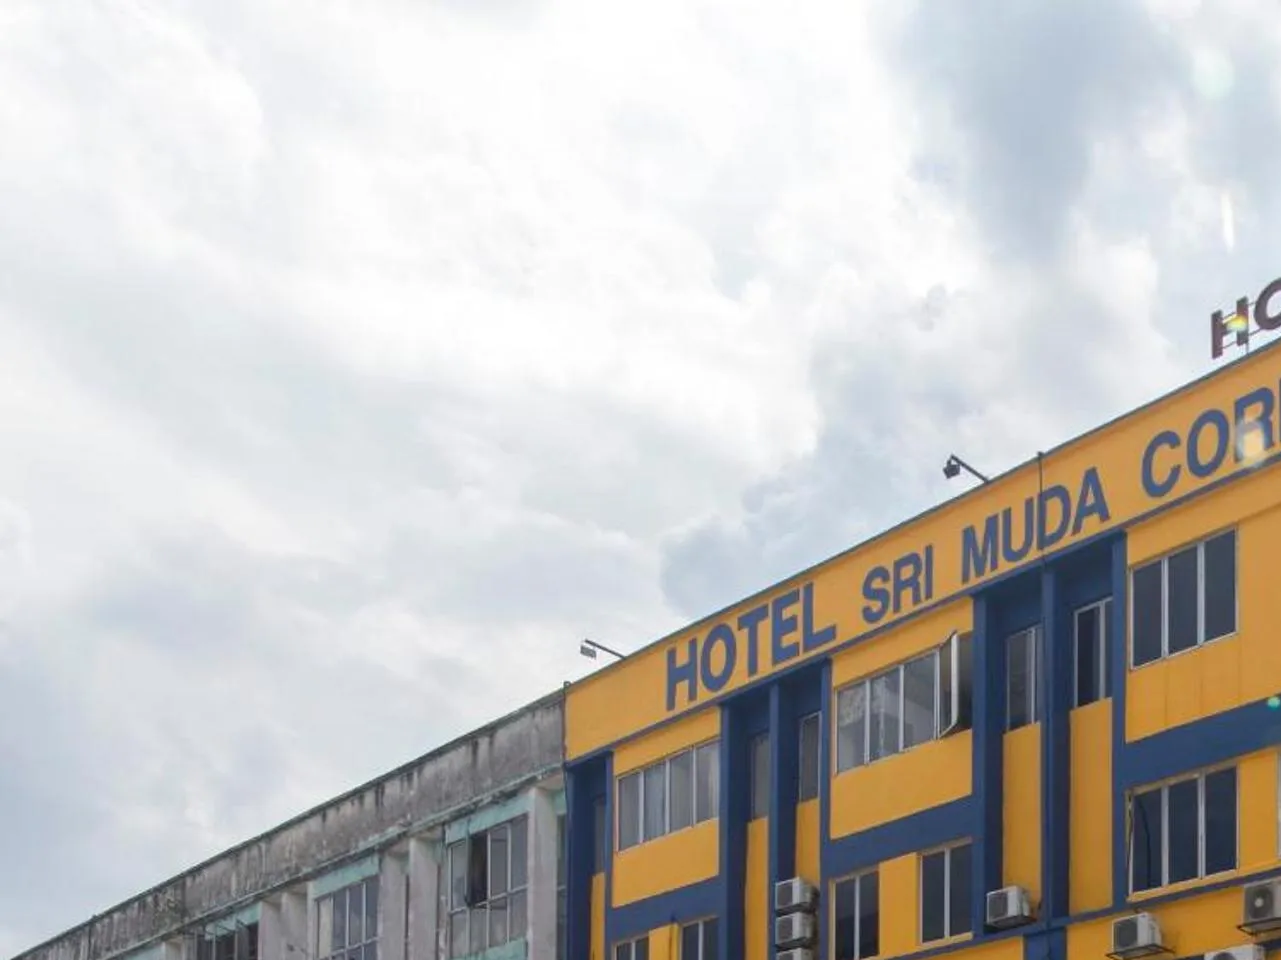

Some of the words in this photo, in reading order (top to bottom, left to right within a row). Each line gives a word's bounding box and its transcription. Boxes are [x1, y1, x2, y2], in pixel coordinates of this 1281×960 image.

[665, 582, 837, 711] HOTEL
[862, 543, 933, 624] SRI
[961, 467, 1110, 583] MUDA
